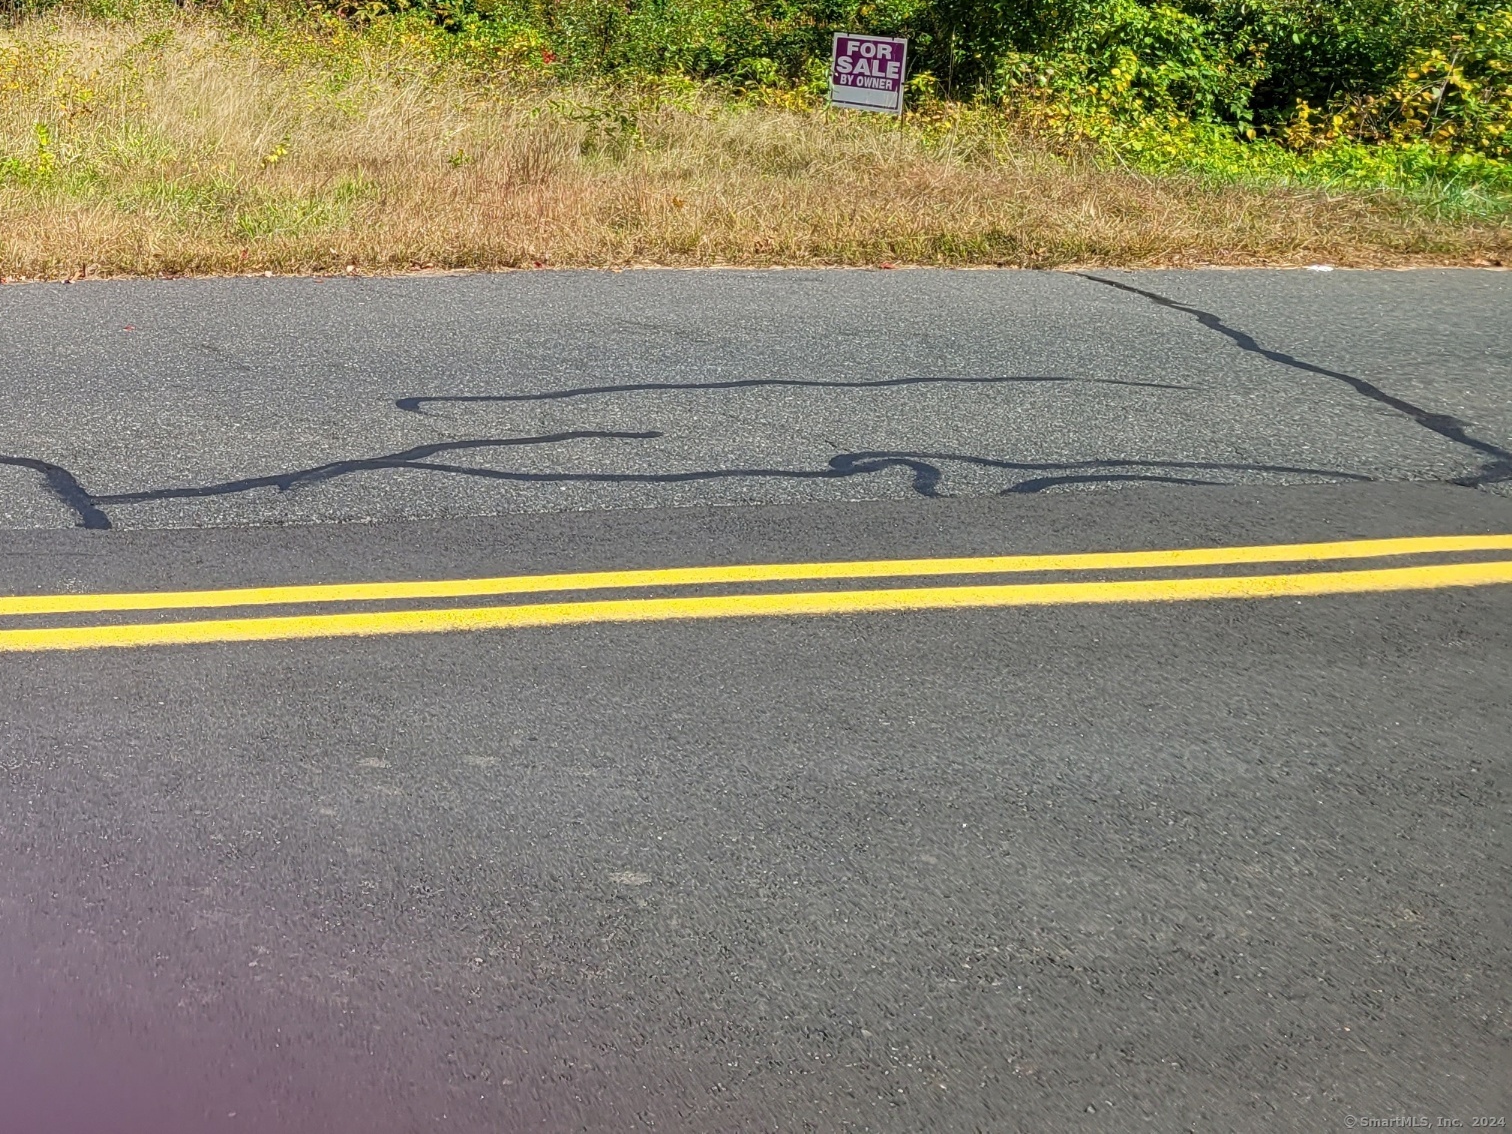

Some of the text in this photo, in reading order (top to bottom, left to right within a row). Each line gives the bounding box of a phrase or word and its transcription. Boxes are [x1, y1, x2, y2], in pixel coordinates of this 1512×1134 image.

[847, 41, 892, 59] FOR
[836, 56, 900, 79] SALE
[840, 74, 892, 90] BY OWNER
